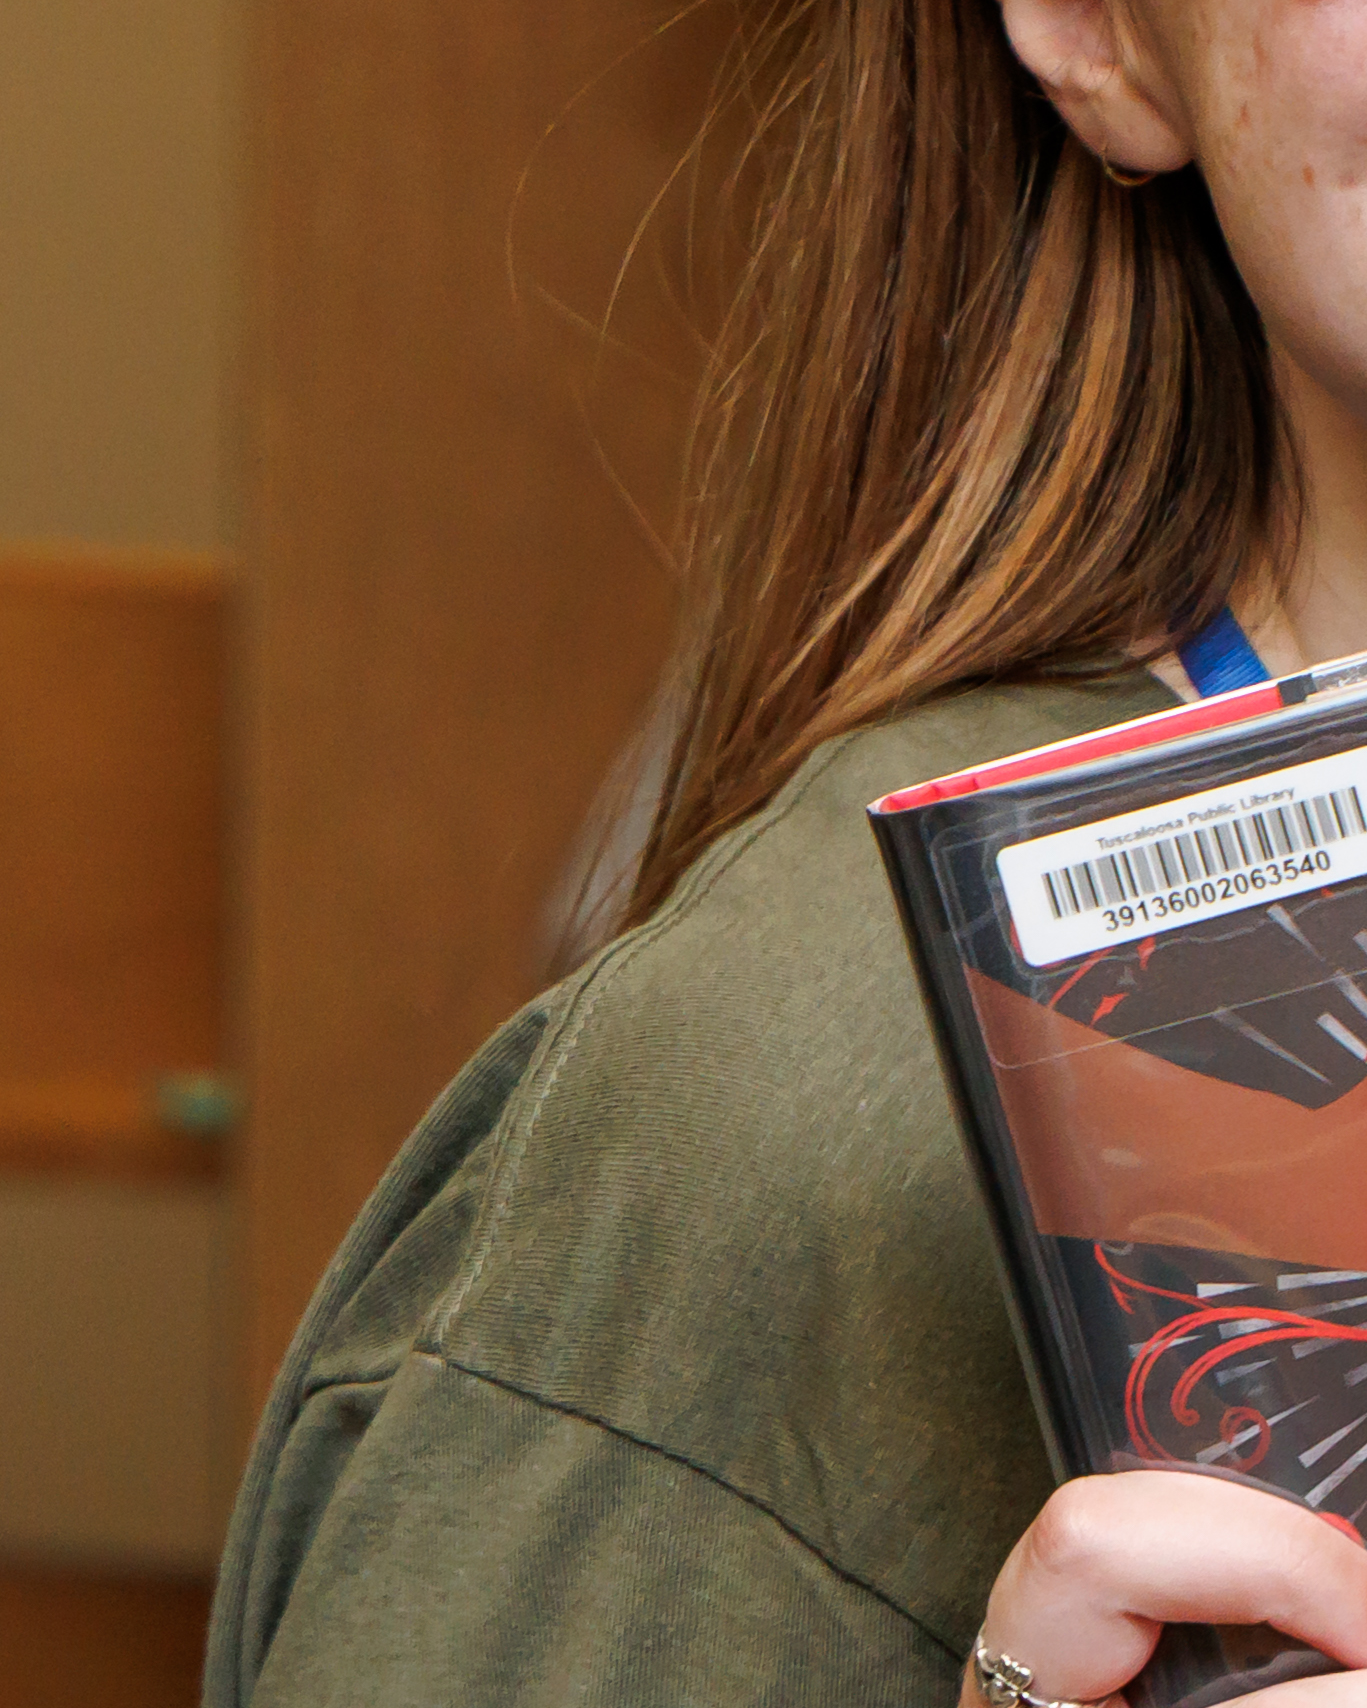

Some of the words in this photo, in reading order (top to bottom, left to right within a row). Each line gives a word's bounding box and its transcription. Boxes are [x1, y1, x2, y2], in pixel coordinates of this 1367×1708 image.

[1096, 818, 1183, 851] Tuscaloosa
[1187, 801, 1236, 826] Public
[1239, 786, 1296, 812] Library
[1102, 849, 1332, 933] 39136002063540
